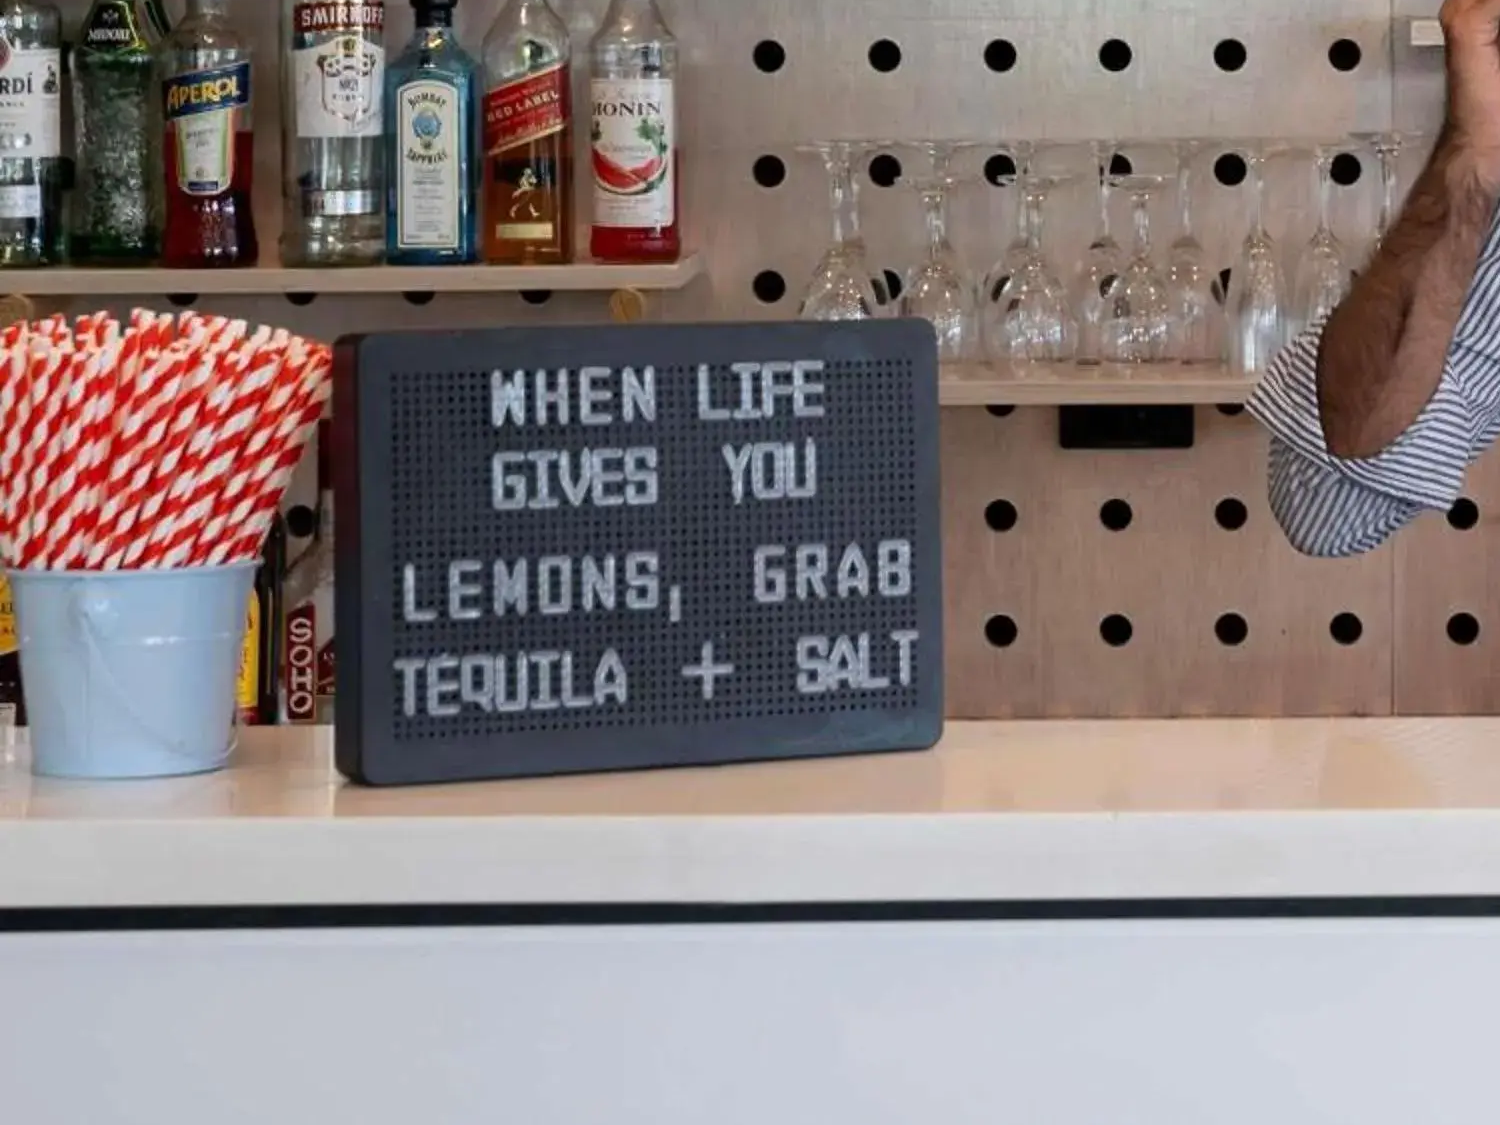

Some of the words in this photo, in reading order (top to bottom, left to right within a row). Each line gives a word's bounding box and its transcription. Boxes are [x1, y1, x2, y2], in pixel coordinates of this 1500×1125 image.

[167, 75, 242, 111] APEROL
[489, 364, 656, 428] WHEN
[698, 359, 825, 421] LIFE
[490, 445, 659, 511] GIVES
[721, 436, 817, 505] YOU
[402, 550, 681, 623] LEMONS,
[289, 615, 313, 715] SOHO
[392, 647, 628, 717] TEQUILA
[796, 629, 920, 694] SALT
